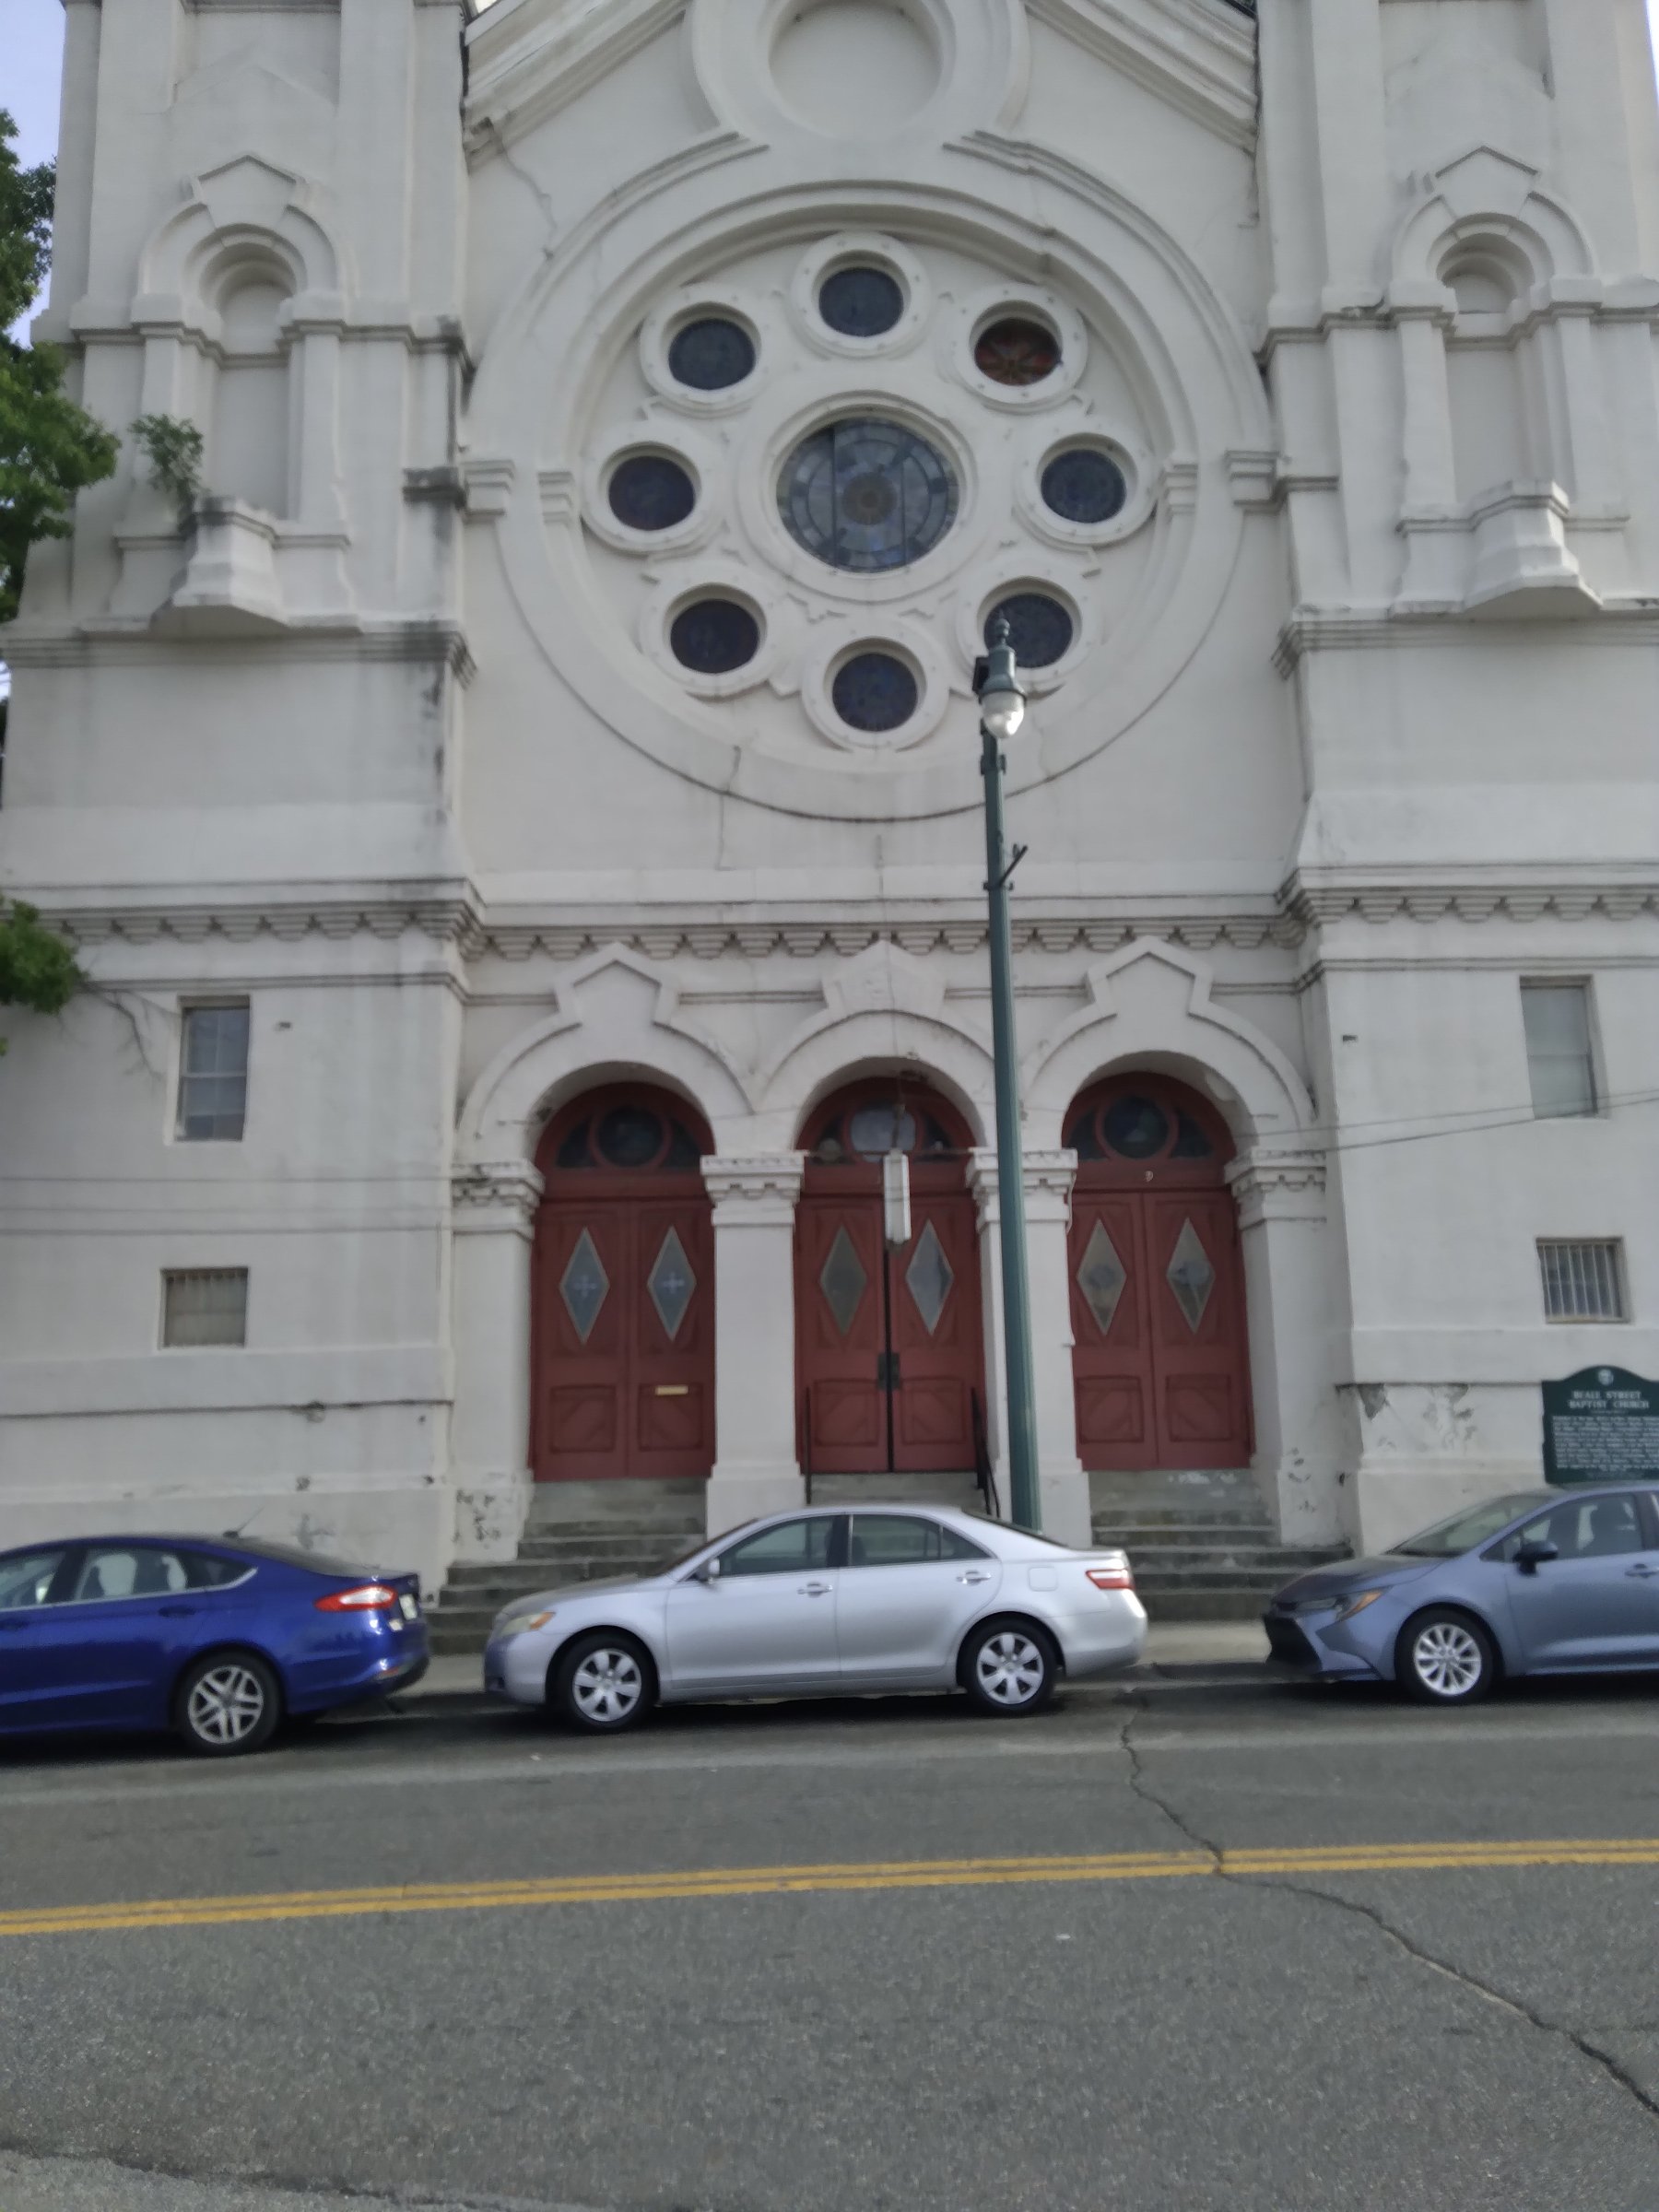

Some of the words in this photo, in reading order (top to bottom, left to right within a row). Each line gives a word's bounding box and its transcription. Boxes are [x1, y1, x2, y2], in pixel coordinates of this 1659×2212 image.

[1606, 1391, 1641, 1399] STREET
[1569, 1400, 1606, 1408] BAPTIST
[1613, 1400, 1650, 1408] CHURCH
